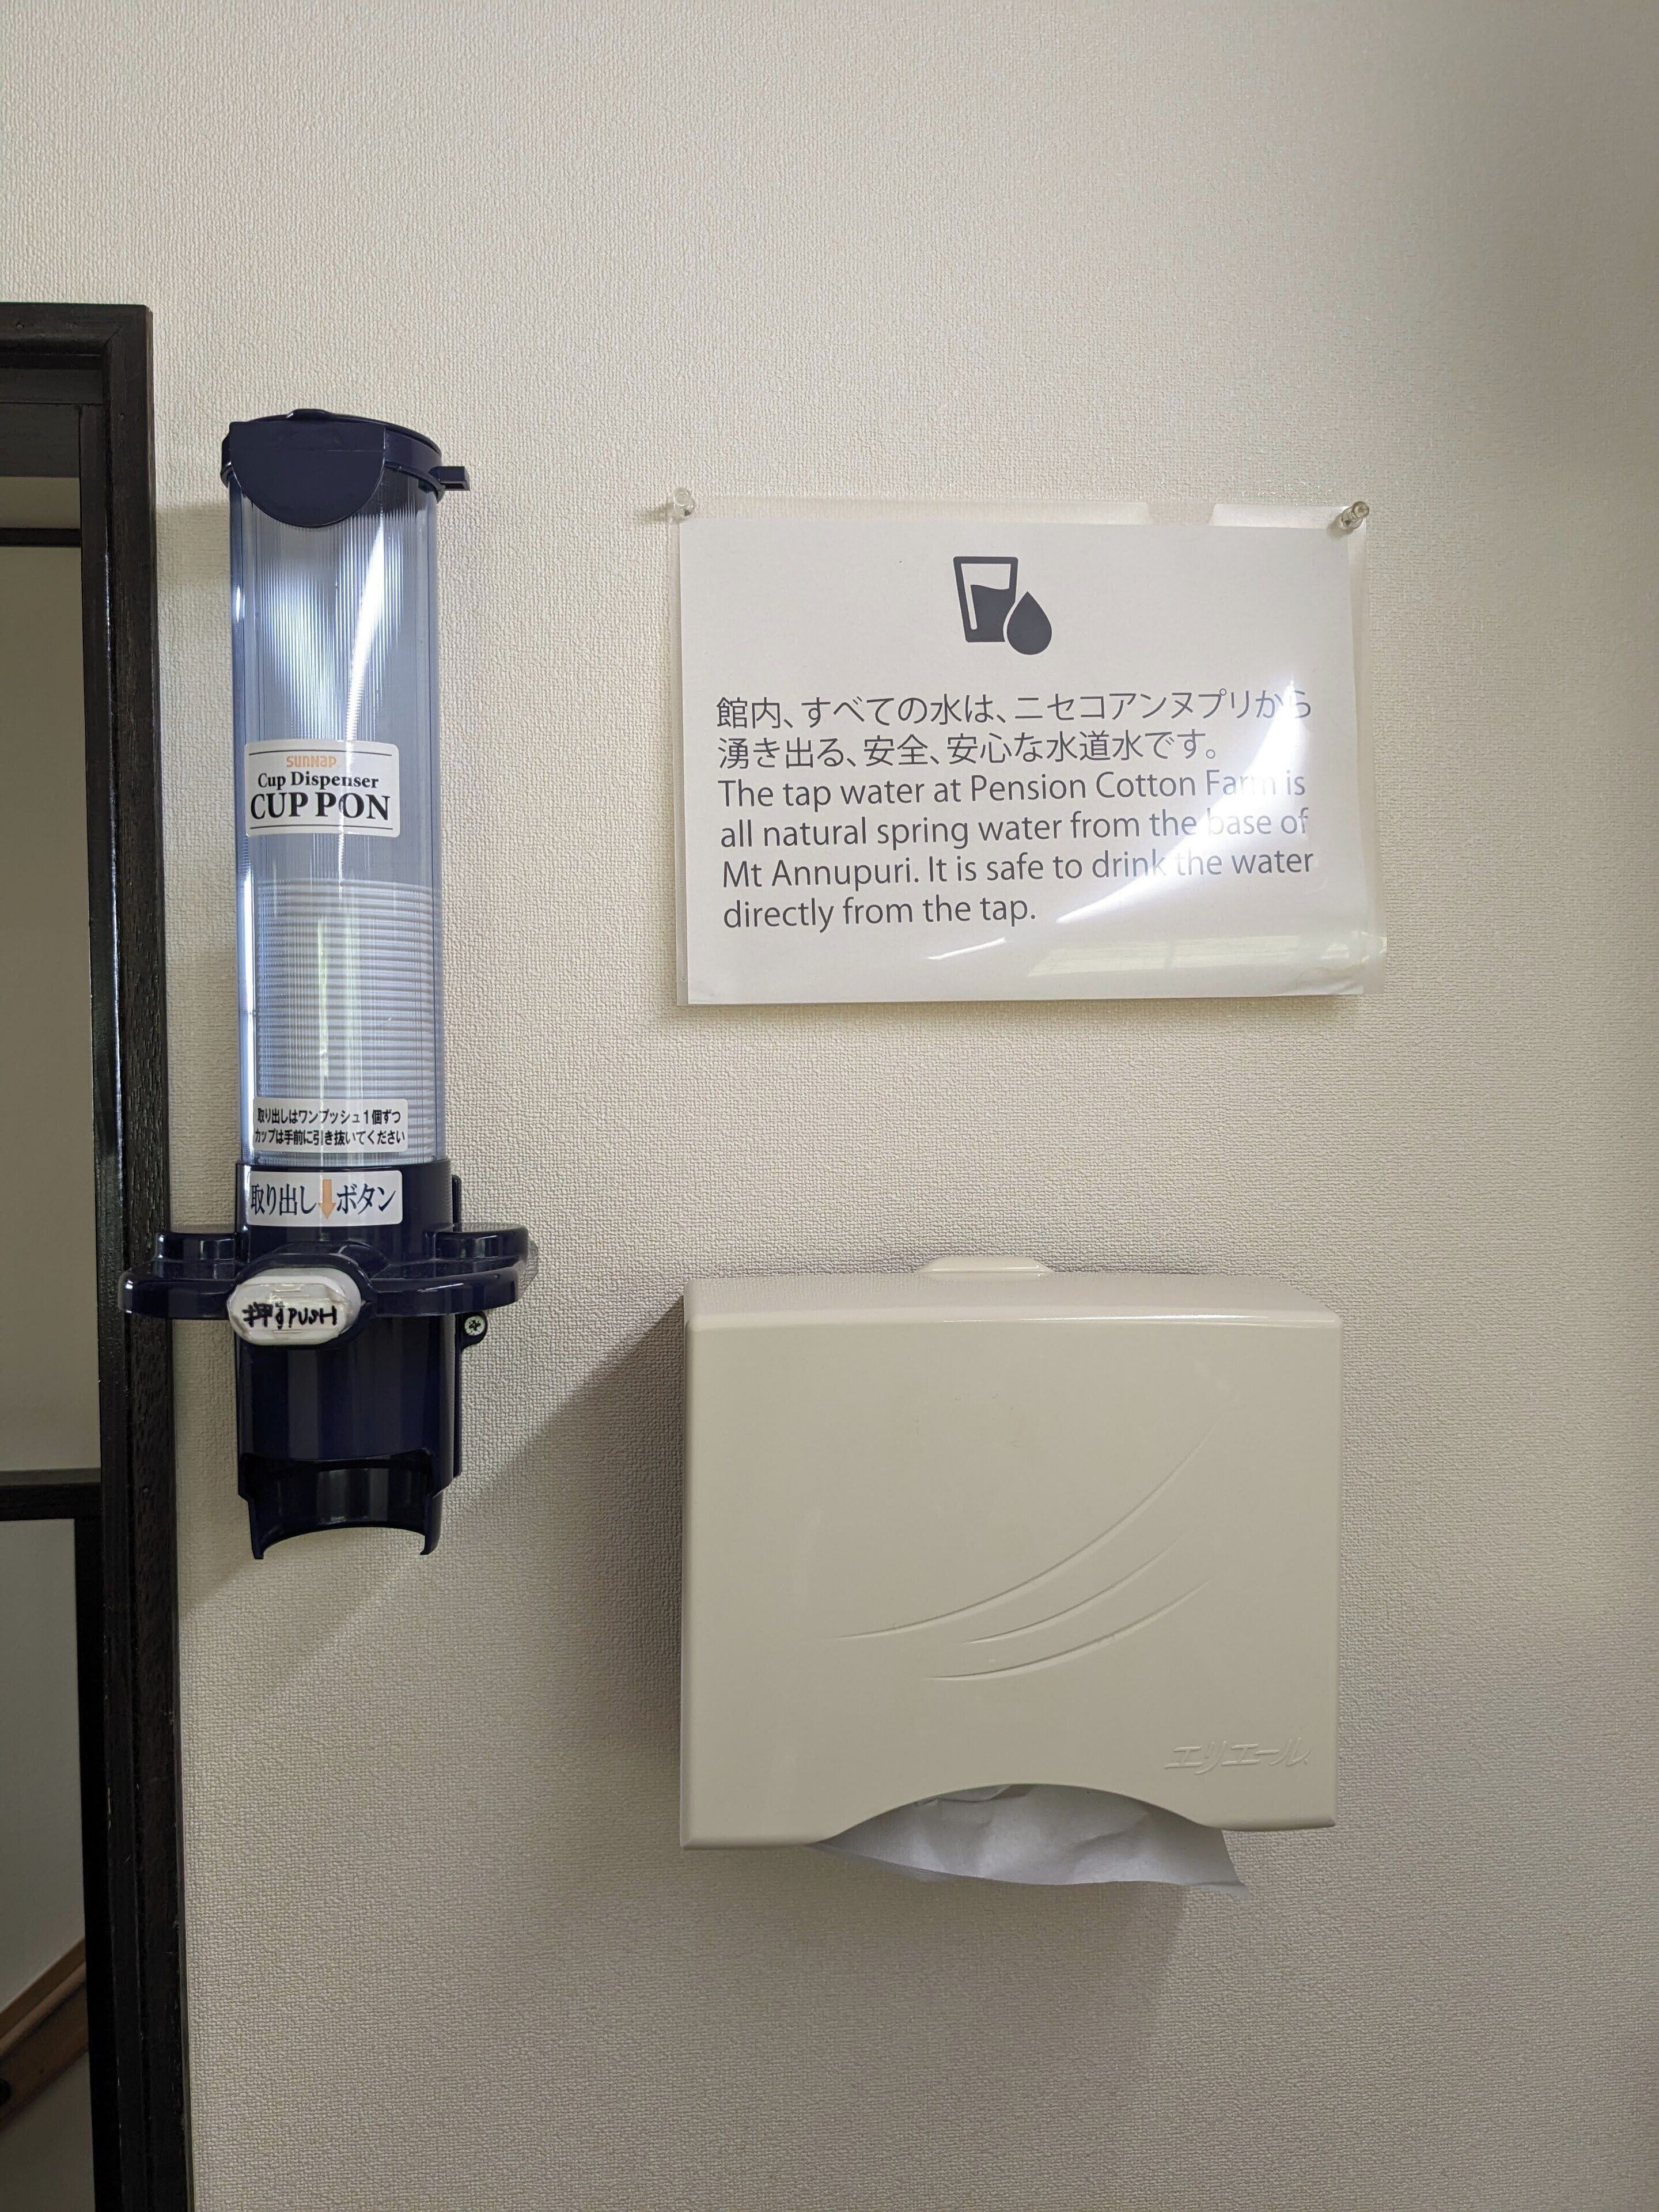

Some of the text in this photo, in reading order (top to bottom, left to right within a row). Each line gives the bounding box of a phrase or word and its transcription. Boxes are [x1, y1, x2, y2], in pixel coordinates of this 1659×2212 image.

[716, 688, 1312, 729] 館内、すべての水は、ニセコアンヌプリから
[718, 728, 1216, 770] 湧き出る、安全、安心な水道水です。
[257, 771, 379, 790] Cup Dispenser
[718, 769, 1306, 812] The tap water at Pension Cotton Farm is
[251, 791, 391, 821] CUP PON
[721, 807, 1309, 850] all natural spring water from the base of
[723, 849, 1314, 891] Mt Annupuri. It is safe to drink the water
[724, 895, 1036, 933] directly from the tap.
[255, 1128, 406, 1146] カップは手前に引き抜いてください
[250, 1183, 396, 1215] 取り出し ボタン
[287, 1305, 338, 1328] PUSH
[1164, 1736, 1311, 1775] エリエール
